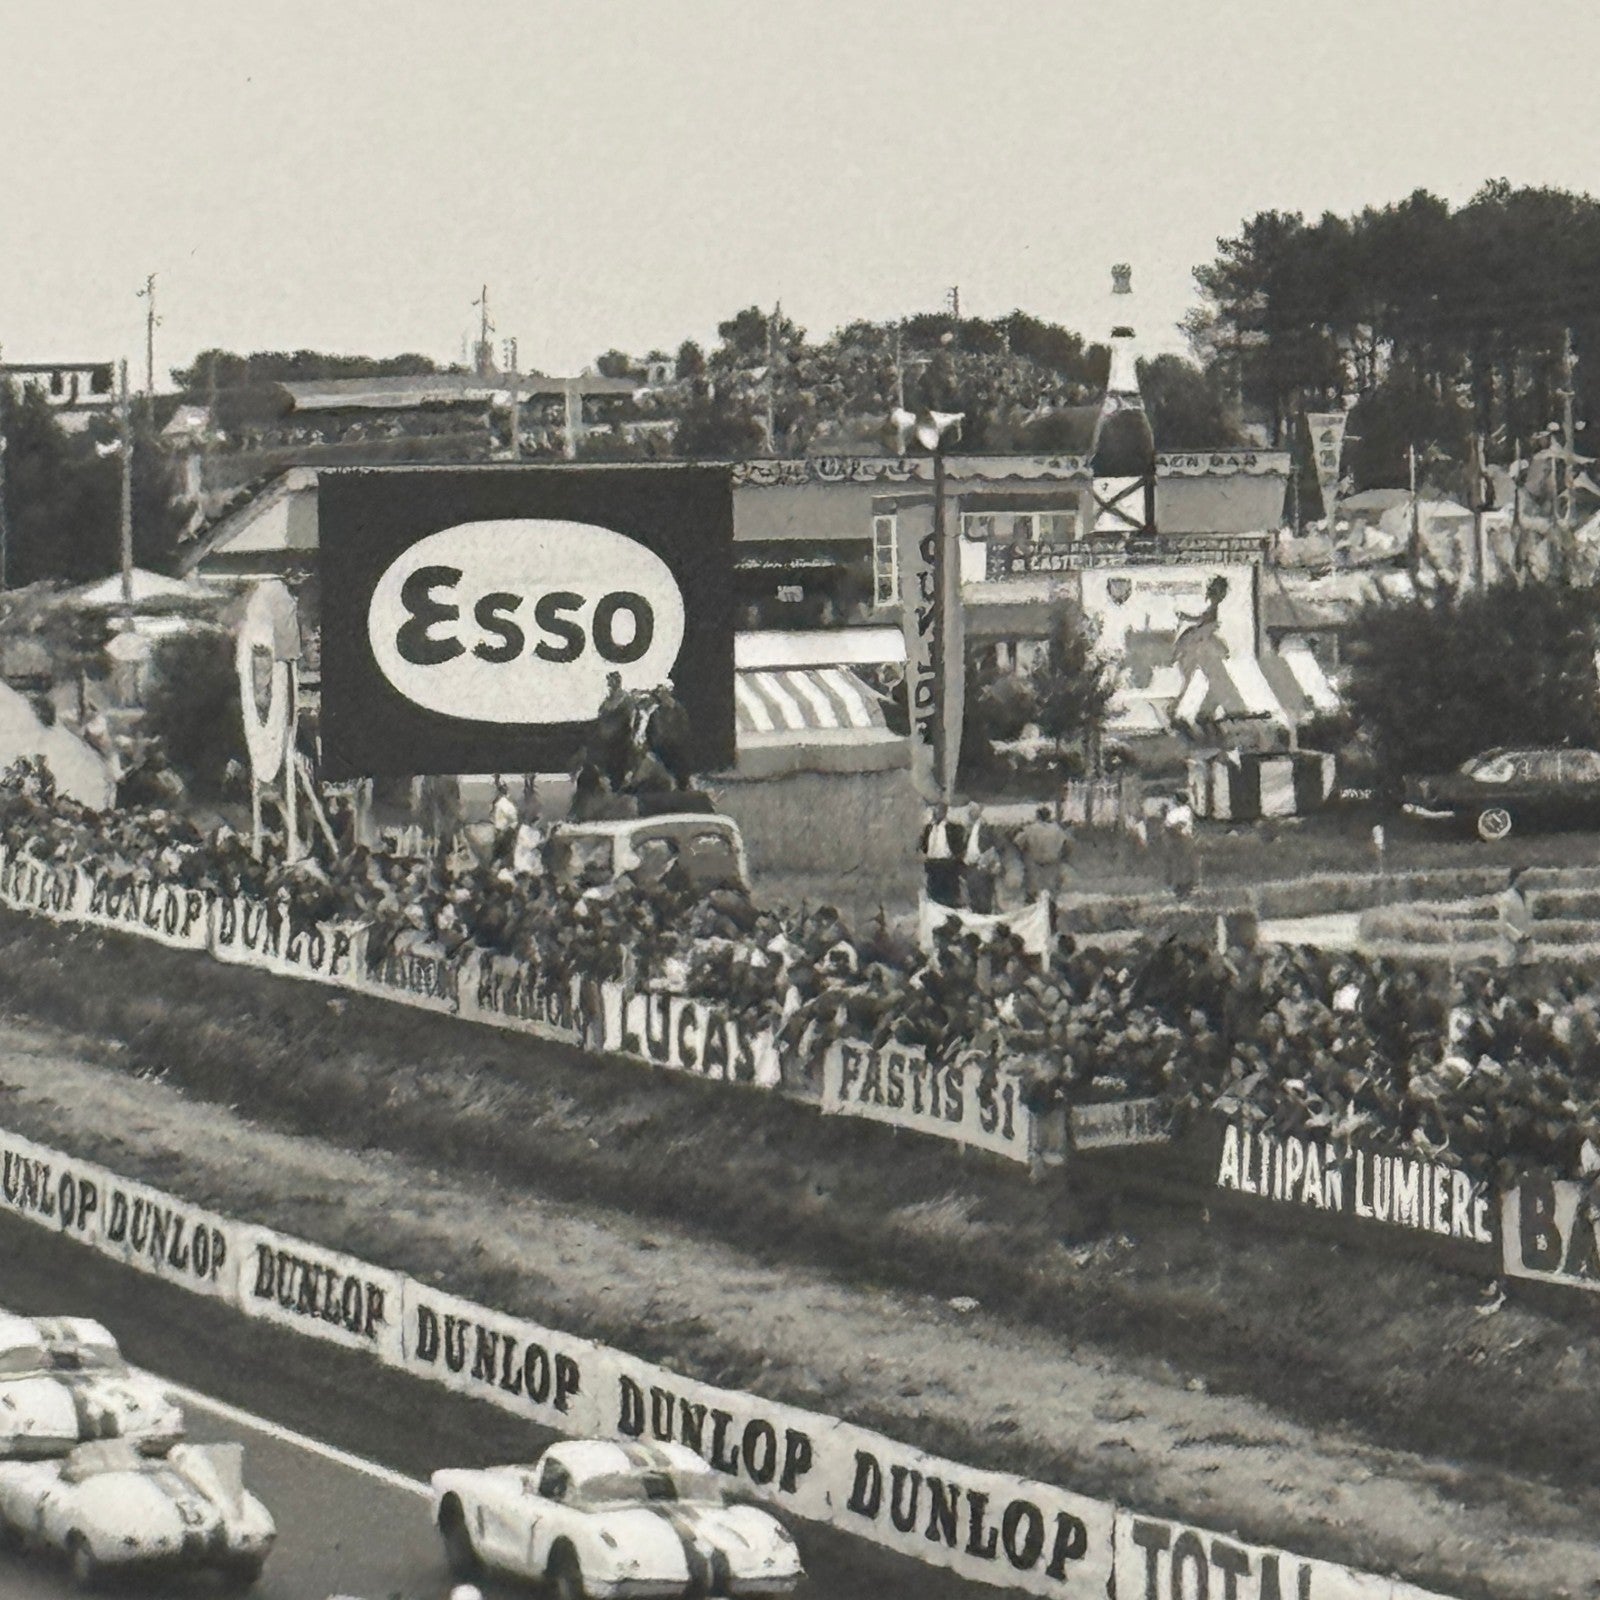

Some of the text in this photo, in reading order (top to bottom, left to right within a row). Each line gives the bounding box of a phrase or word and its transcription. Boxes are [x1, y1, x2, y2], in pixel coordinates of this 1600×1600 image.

[108, 1190, 227, 1282] DUNLOP
[254, 1243, 388, 1338] DUNLOP
[416, 1304, 581, 1415] DUNLOP
[618, 1374, 813, 1494] DUNLOP
[847, 1449, 1088, 1581] DUNLOP
